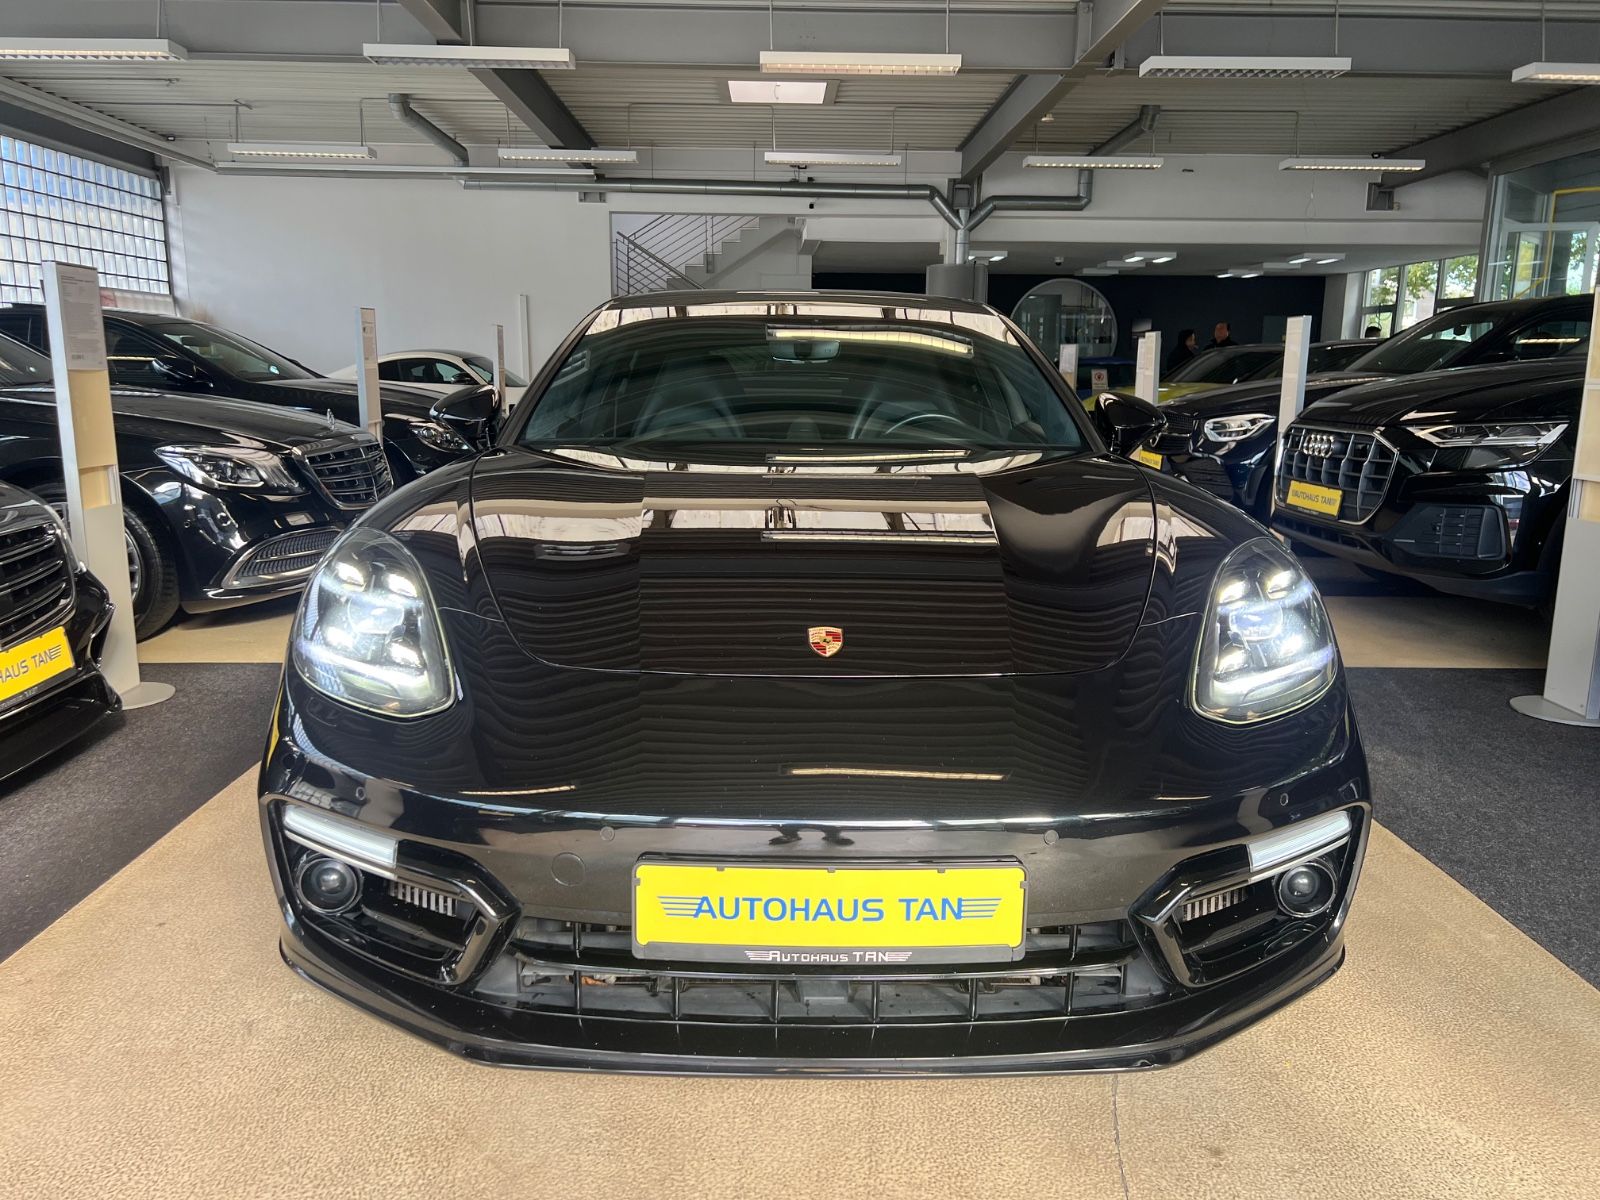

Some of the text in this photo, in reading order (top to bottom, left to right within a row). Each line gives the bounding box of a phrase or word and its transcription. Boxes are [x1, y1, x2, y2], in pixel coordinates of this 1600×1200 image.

[31, 650, 51, 668] TAN
[693, 896, 963, 921] AUTOHAUS TAN
[852, 952, 888, 962] TAN
